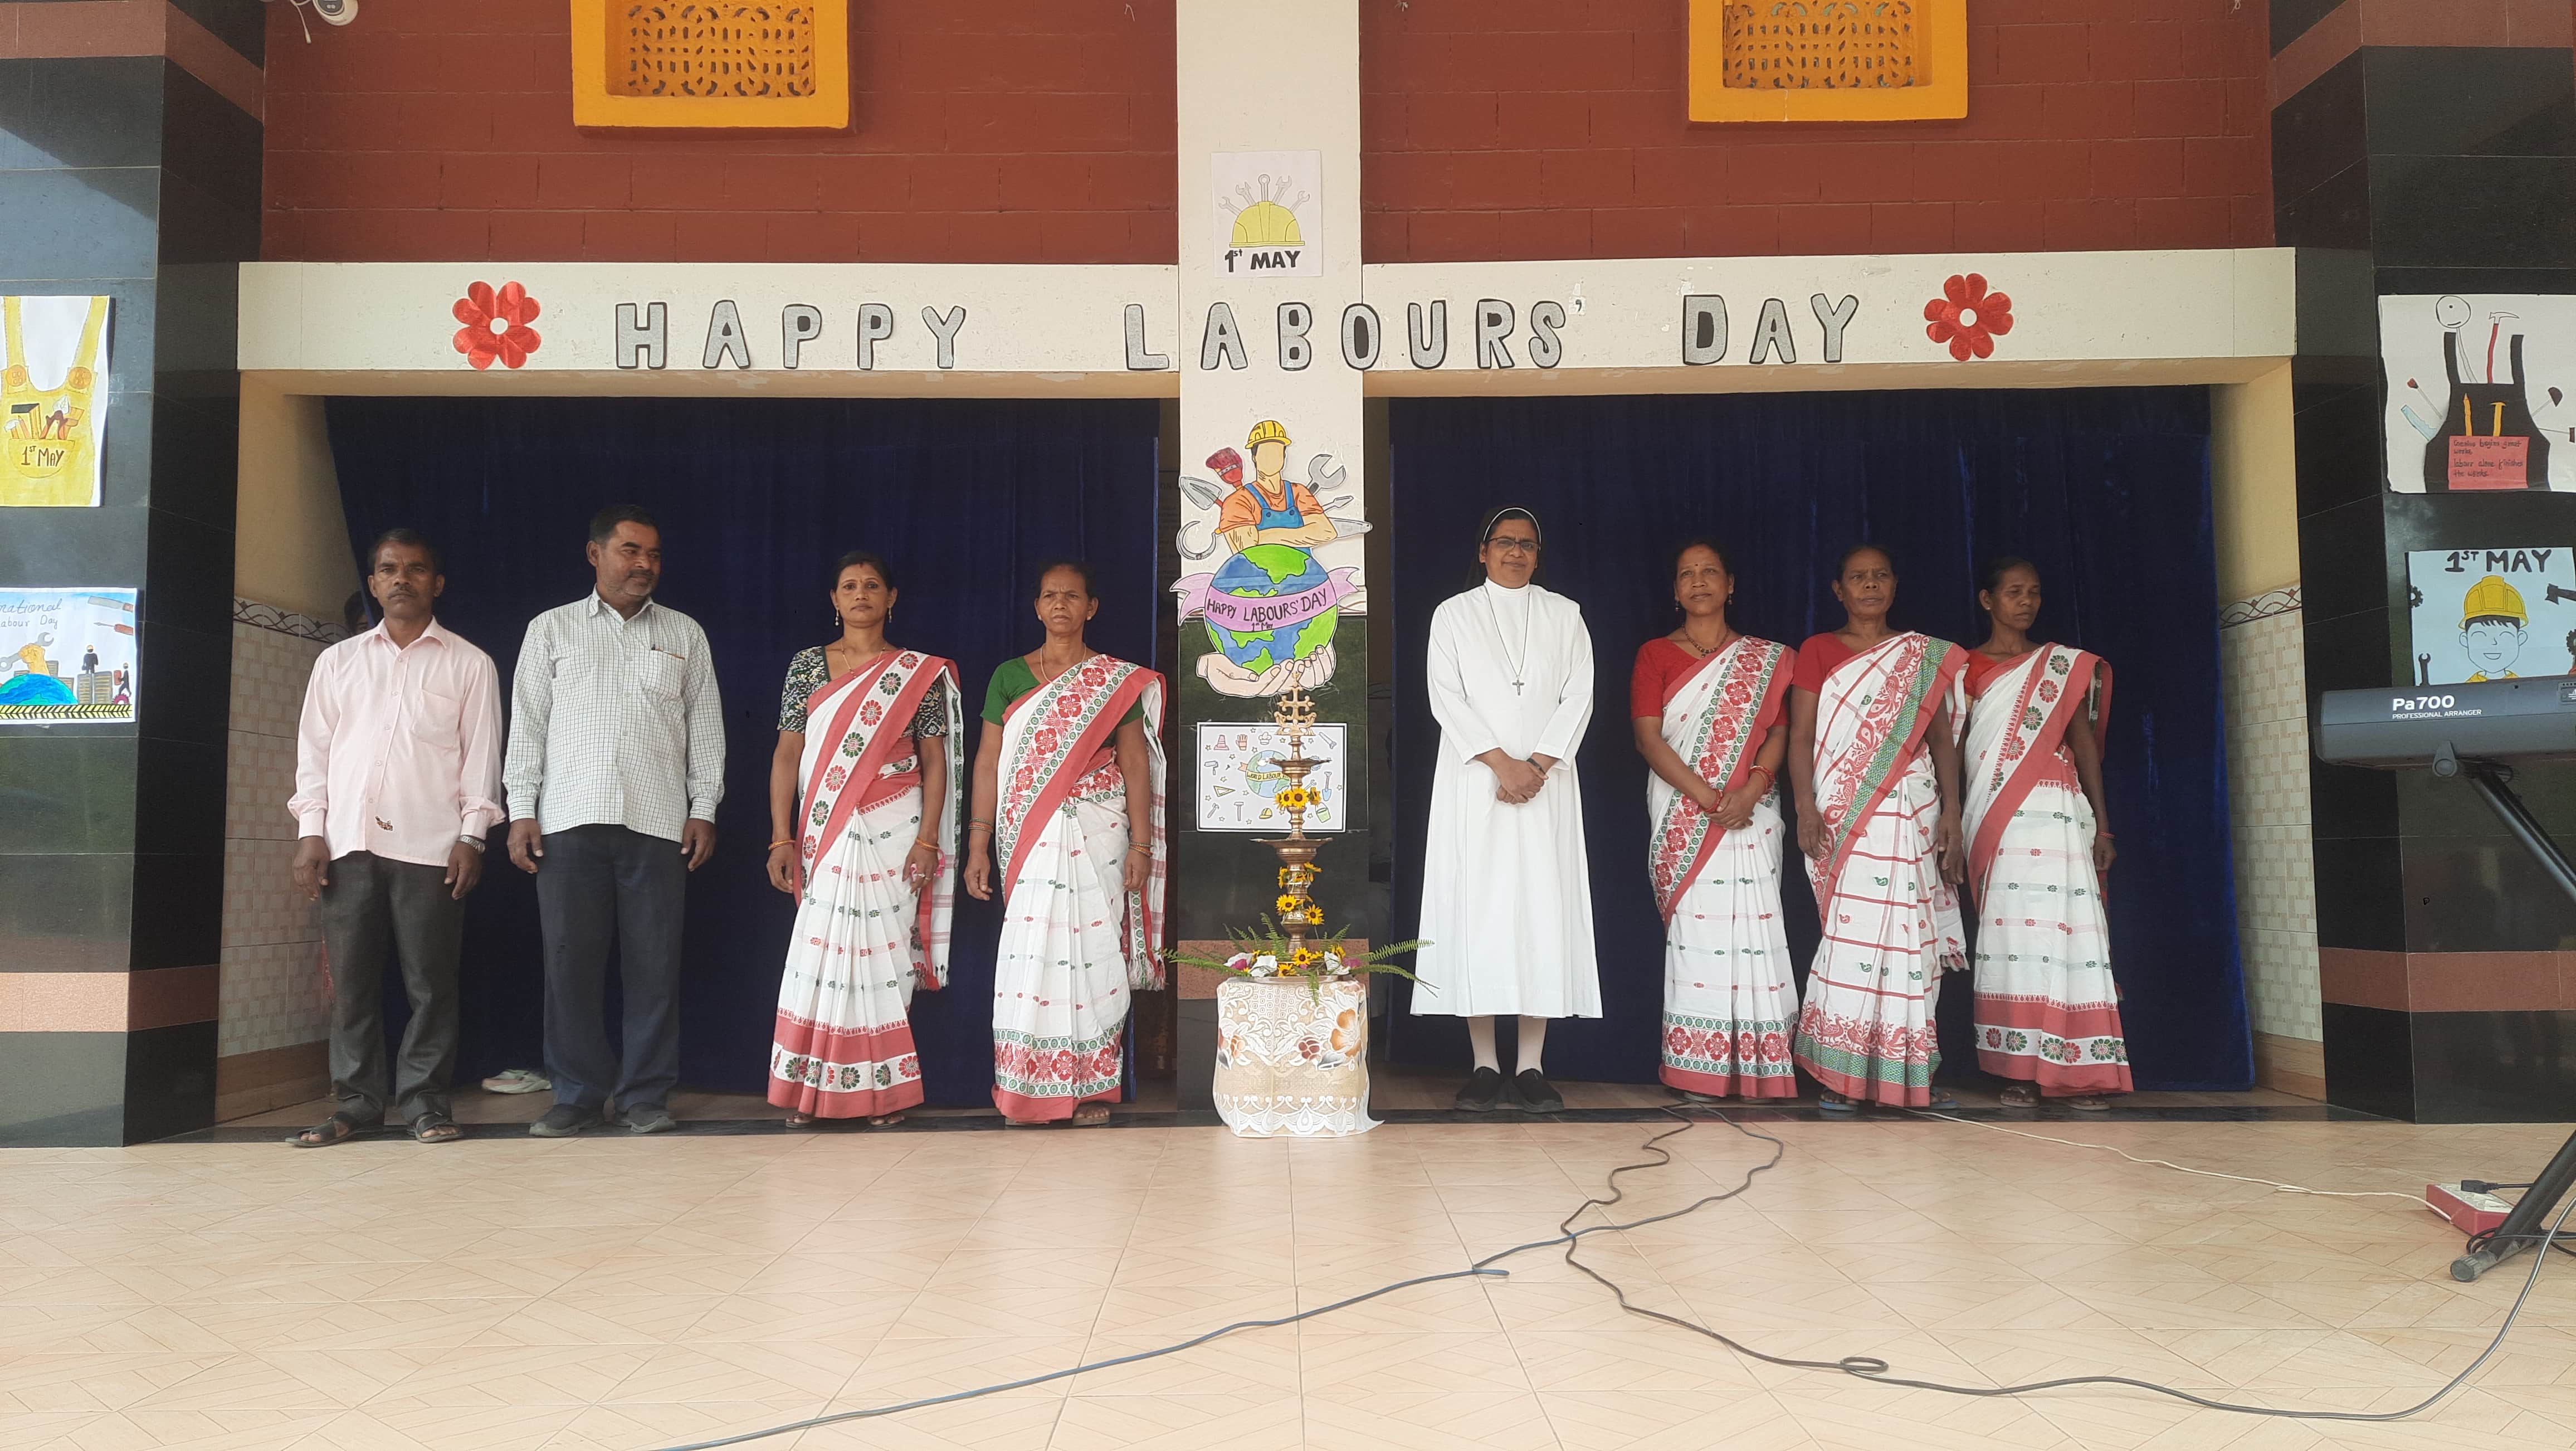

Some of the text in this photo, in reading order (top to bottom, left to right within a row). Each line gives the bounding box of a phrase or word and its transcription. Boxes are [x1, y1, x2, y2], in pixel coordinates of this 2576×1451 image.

[1250, 250, 1301, 270] MAY
[615, 299, 967, 370] HAPPY
[1682, 293, 1860, 366] DAY
[2486, 549, 2552, 573] MAY
[1207, 598, 1237, 619] HAPPY
[1300, 588, 1328, 612] DAY
[0, 615, 58, 630] abour Day
[2392, 694, 2455, 712] Pa700
[2392, 709, 2482, 720] PROFESSIONAL ARRANGER
